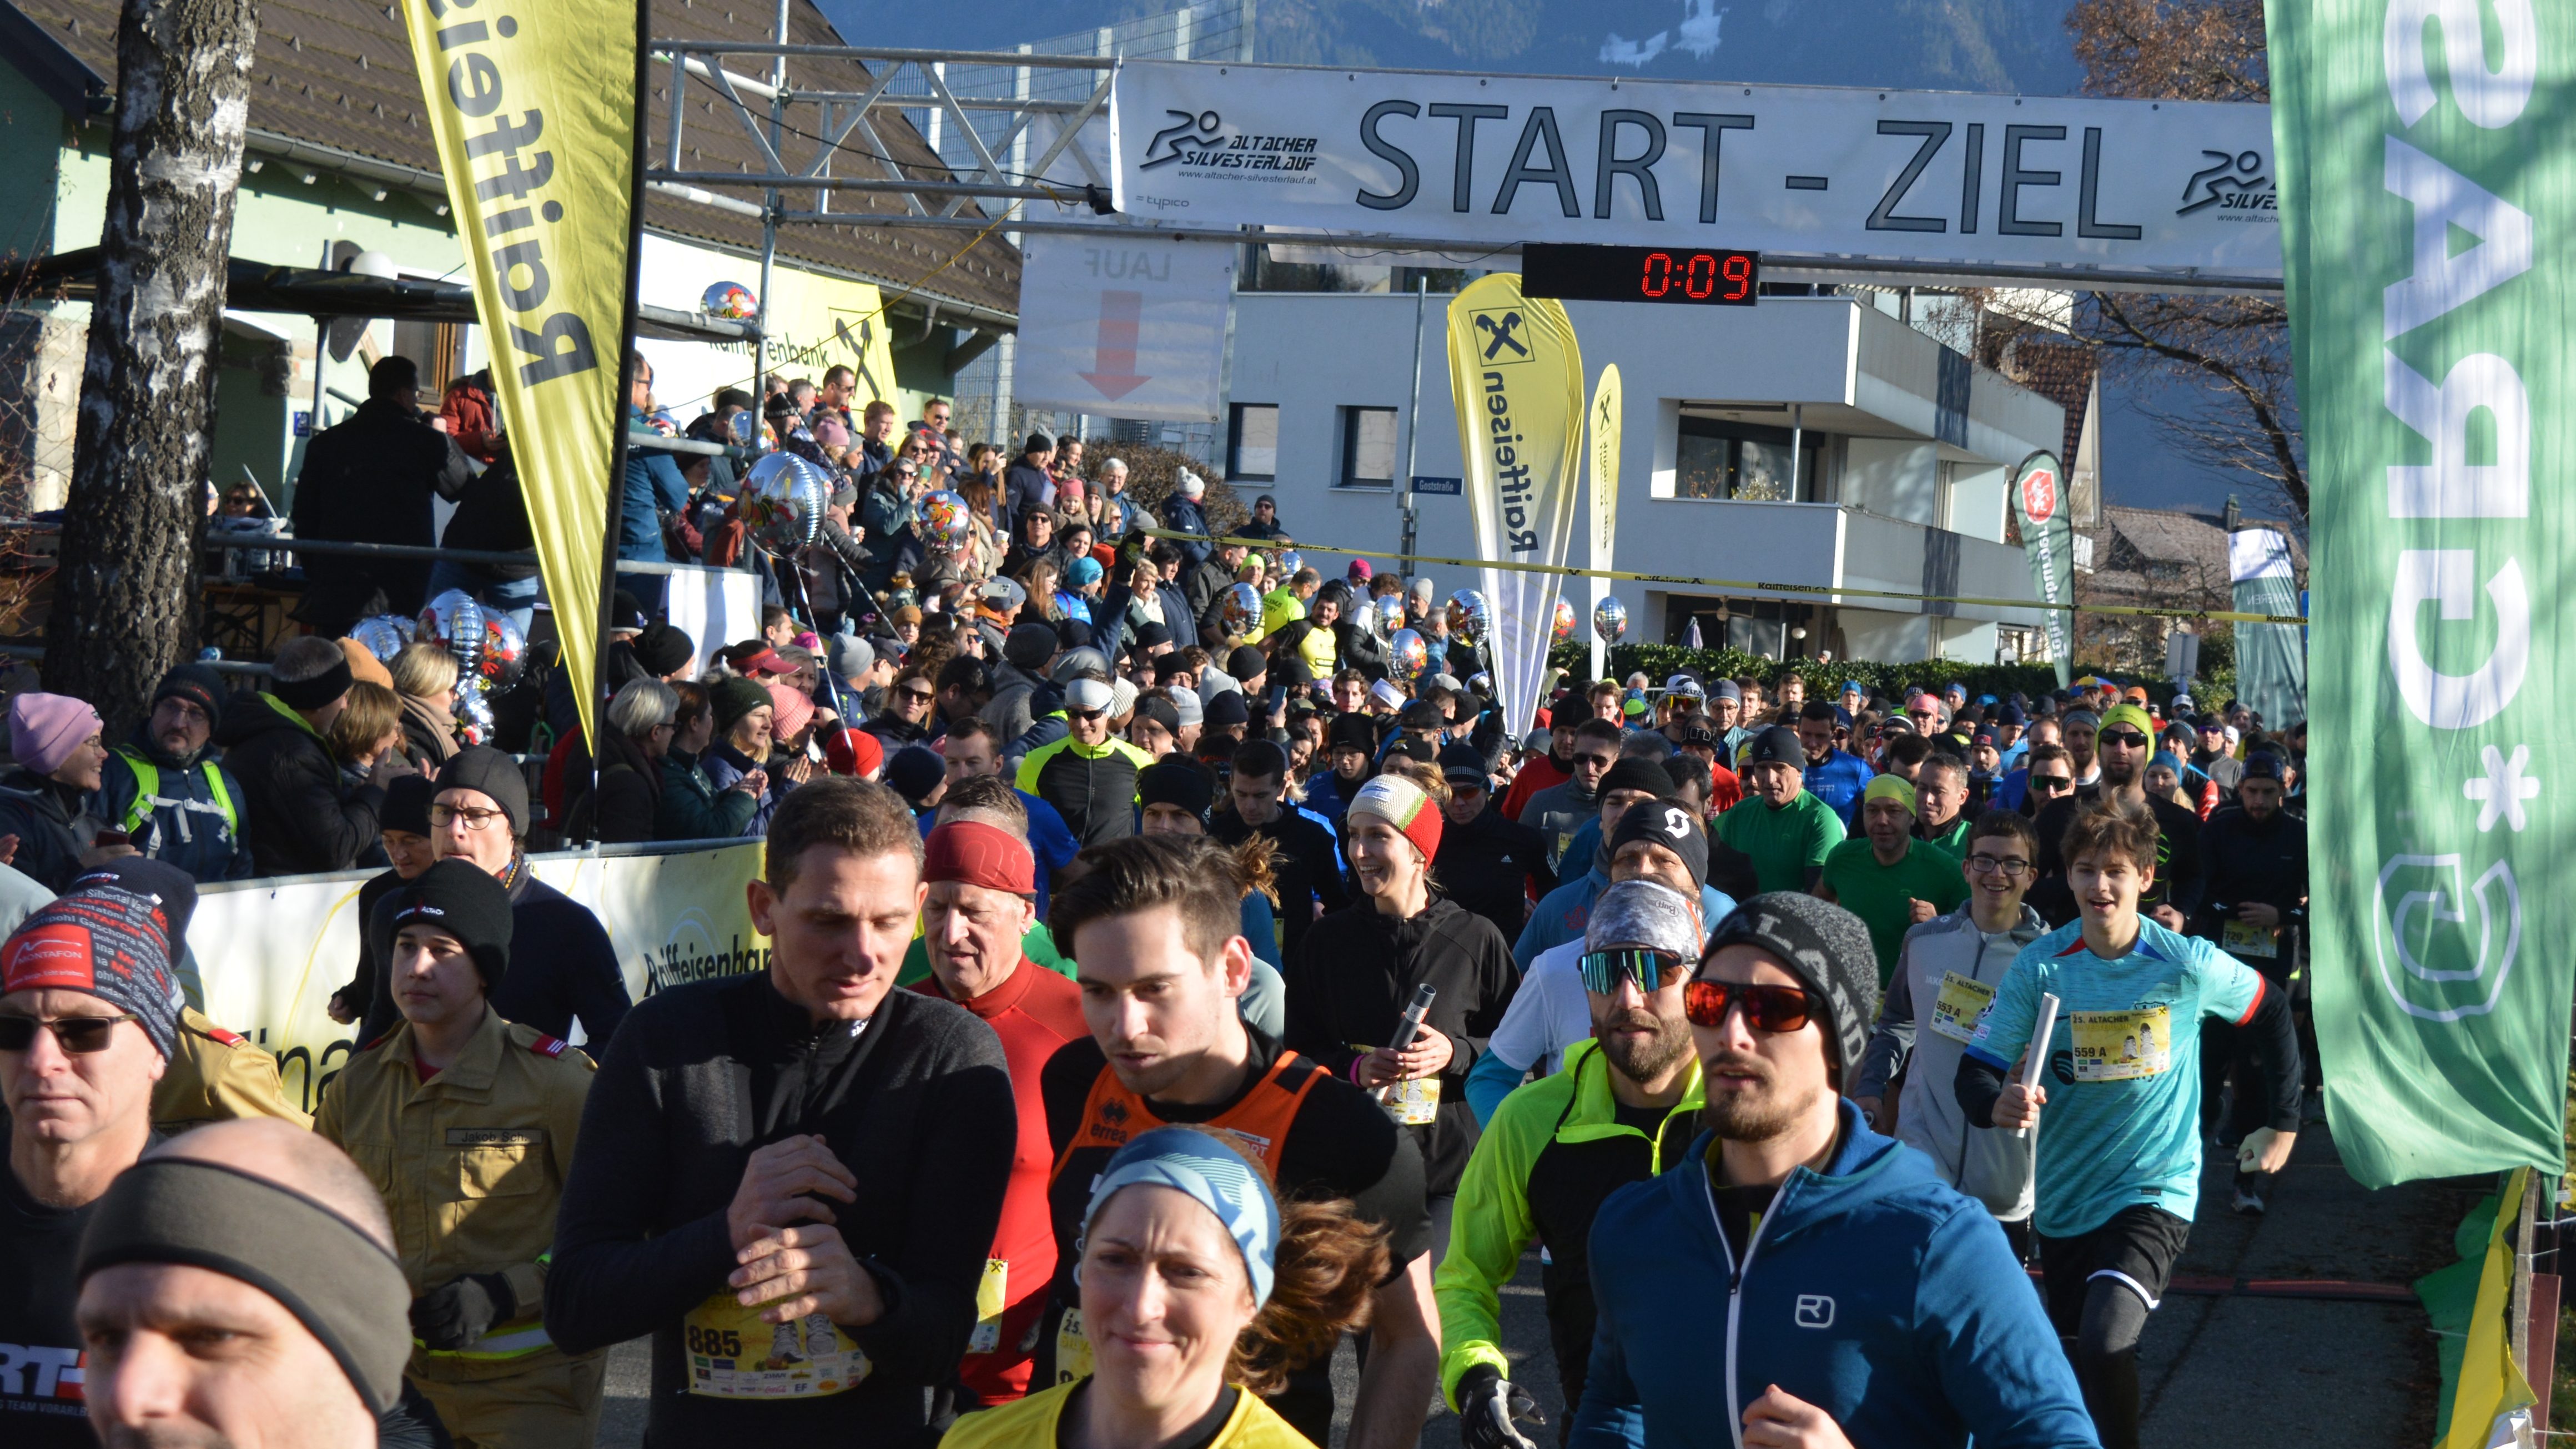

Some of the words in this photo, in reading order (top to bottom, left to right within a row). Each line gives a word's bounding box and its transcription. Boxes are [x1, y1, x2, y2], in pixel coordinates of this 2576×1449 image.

[1228, 135, 1318, 153] ALTACHER
[1181, 151, 1317, 171] SILVESTERLAUF
[1356, 99, 1755, 224] START
[1785, 175, 1828, 191] -
[1865, 119, 2142, 240] ZIEL
[1178, 169, 1317, 185] www.altacher-silvesterlauf.at
[1146, 195, 1189, 210] typico
[1642, 253, 1751, 301] 0:09
[1419, 480, 1454, 492] Goststraße
[2225, 931, 2243, 941] 720
[17, 950, 83, 965] MONTAFON
[1956, 979, 1991, 996] ALTACHER
[1936, 1000, 1953, 1014] 553
[1953, 1008, 1961, 1018] A
[2072, 1015, 2086, 1024] 25.
[2074, 1047, 2096, 1057] 559
[2099, 1046, 2107, 1057] A
[461, 1131, 496, 1143] Jakob
[501, 1131, 528, 1143] Sch.
[1064, 1318, 1083, 1336] 25.
[687, 1325, 742, 1358] 885
[7, 1400, 37, 1413] TEAM
[39, 1402, 89, 1417] VORARLB
